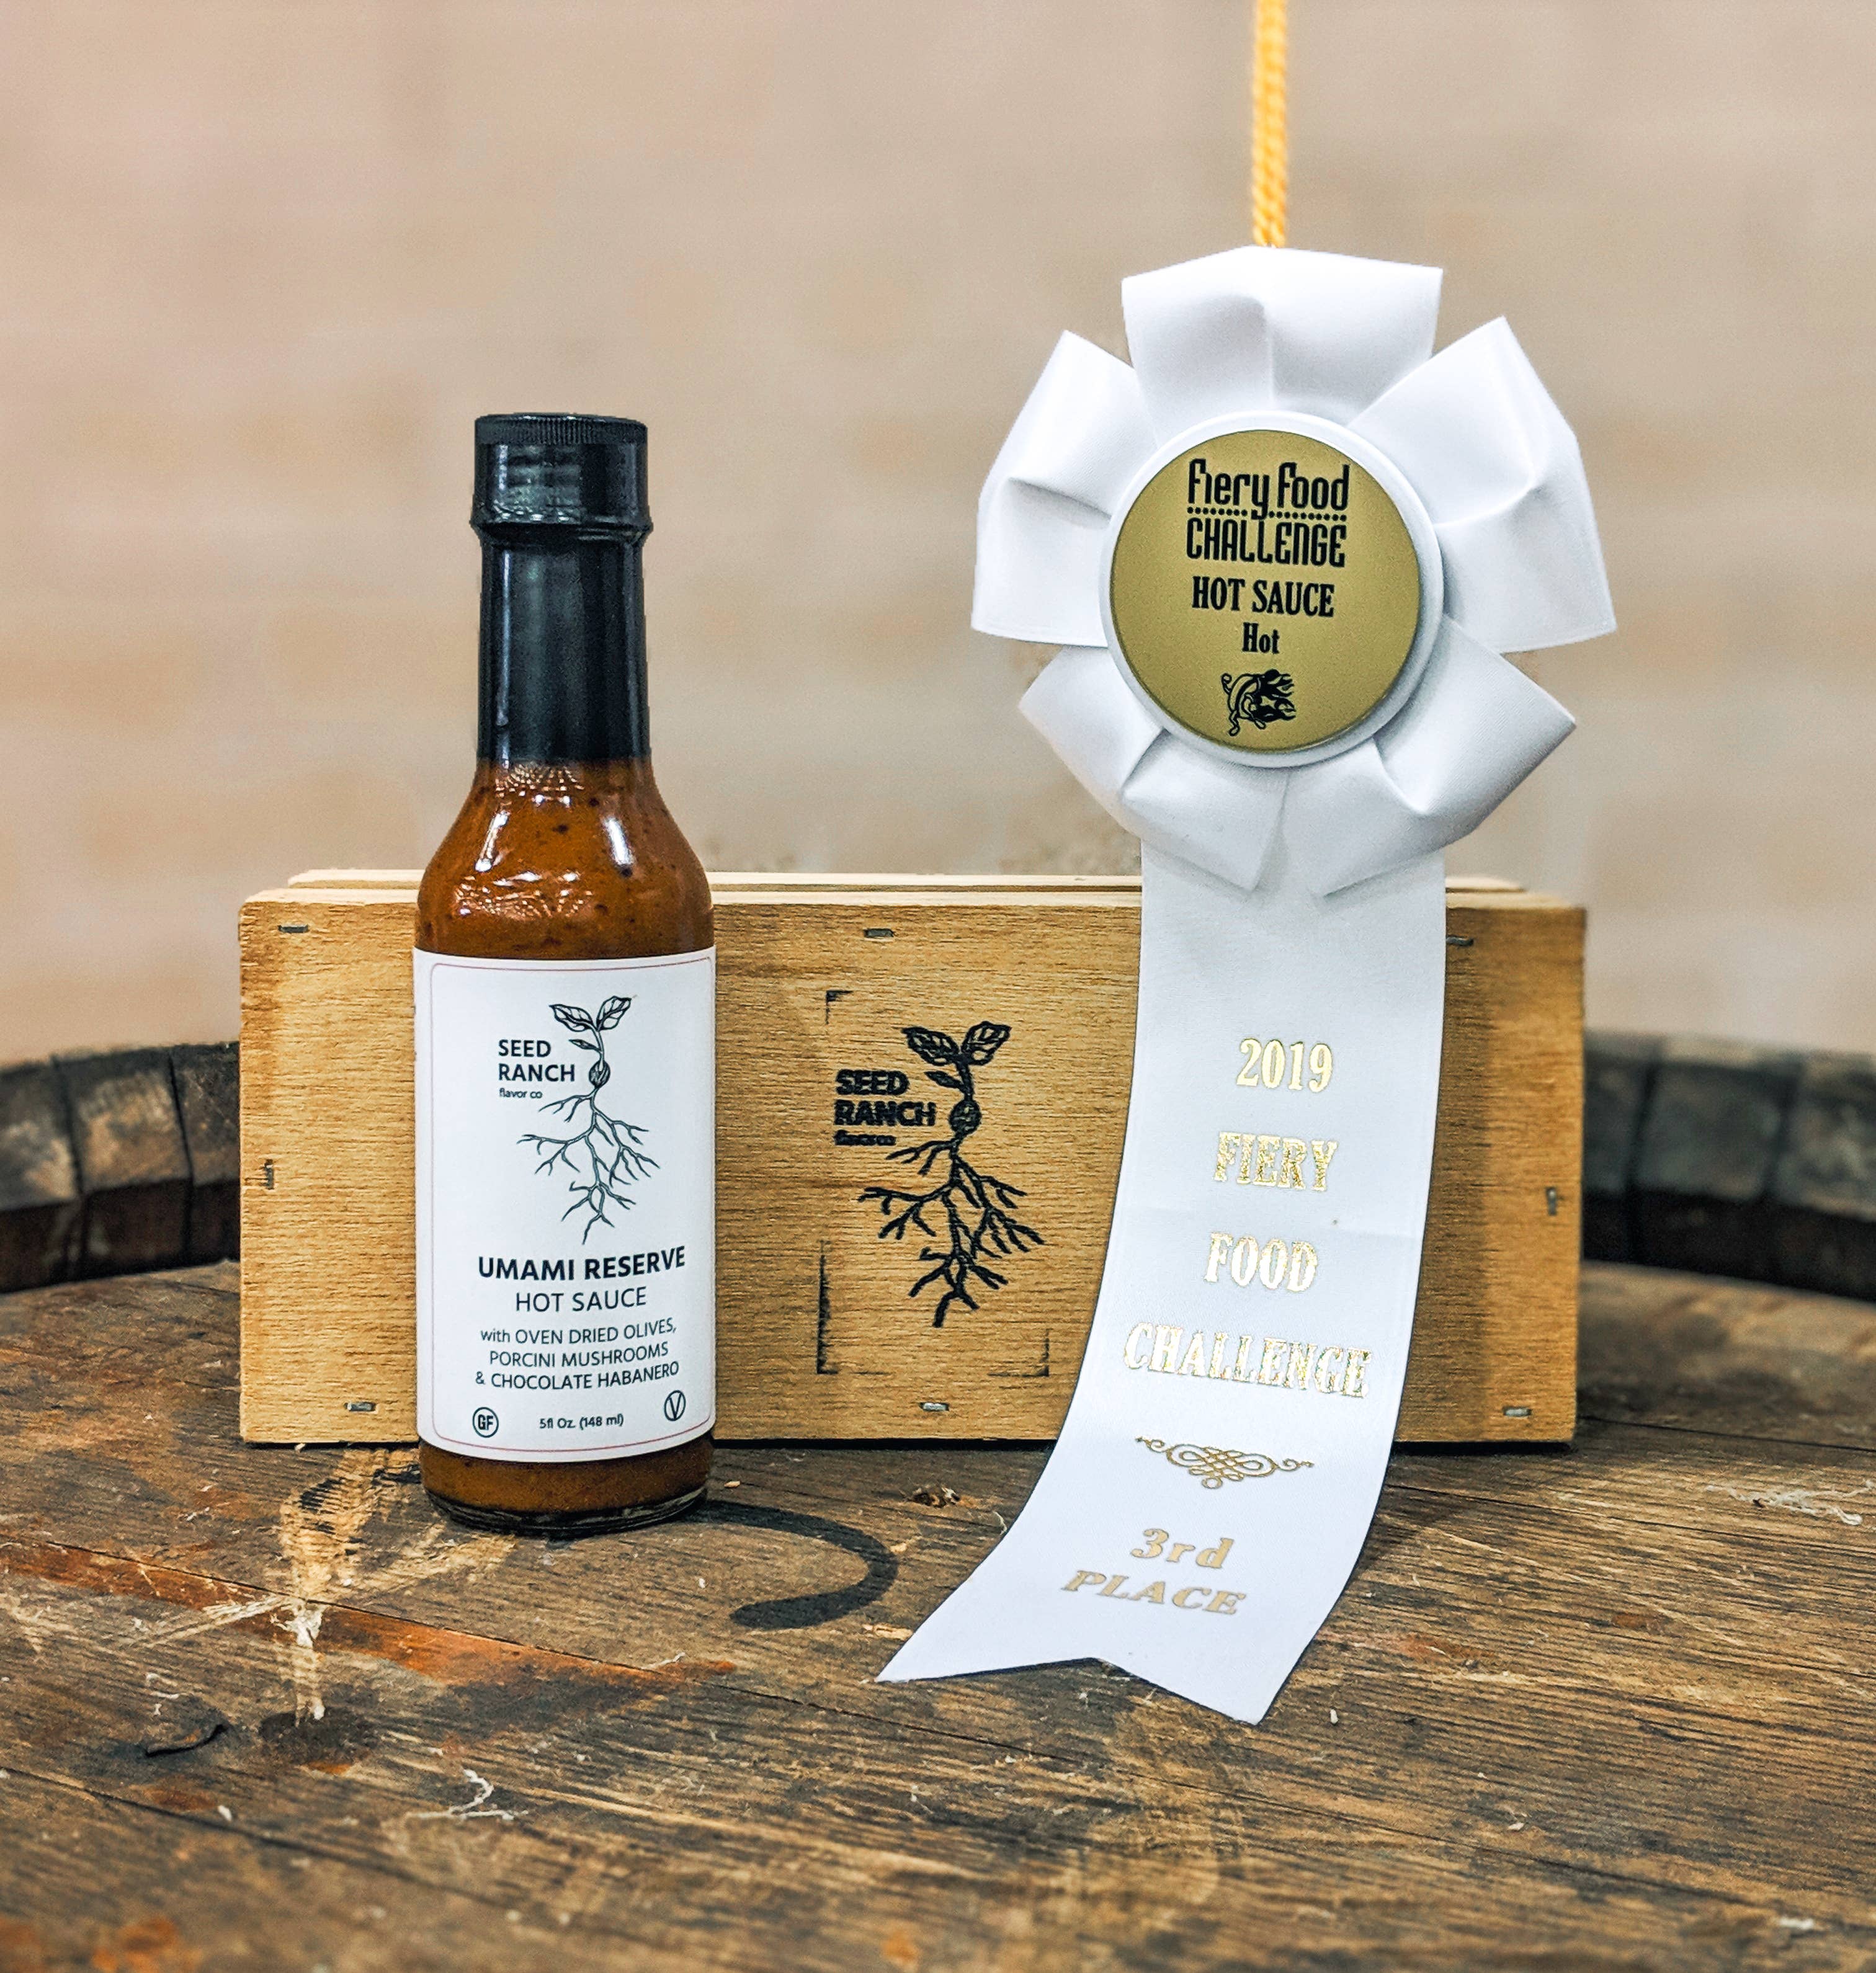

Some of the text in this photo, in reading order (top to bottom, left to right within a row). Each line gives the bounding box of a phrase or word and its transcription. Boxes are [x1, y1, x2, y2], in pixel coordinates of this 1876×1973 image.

[1186, 517, 1347, 568] CHALLENGE
[1192, 576, 1335, 618] HOT SAUCE
[1242, 622, 1280, 654] Hot
[498, 1040, 551, 1057] SEED
[498, 1064, 575, 1082] RANCH
[1236, 1038, 1333, 1092] 2019
[499, 1088, 543, 1099] flavor co
[835, 1069, 910, 1095] SEED
[834, 1099, 937, 1126] RANCH
[1212, 1131, 1339, 1191] FIERY
[478, 1245, 686, 1280] UMAMI RESERVE
[1204, 1231, 1319, 1292] FOOD
[516, 1286, 646, 1312] HOT SAUCE
[480, 1317, 677, 1345] with OVEN DRIED OLIVES,
[489, 1342, 669, 1367] PORCINI MUSHROOMS
[1123, 1322, 1373, 1399] CHALLENGE
[476, 1361, 679, 1390] & CHOCOLATE HABANERO
[478, 1414, 494, 1430] GF
[579, 1415, 602, 1430] (148
[606, 1413, 624, 1426] ml)
[1130, 1528, 1235, 1569] 3rd
[1061, 1570, 1247, 1615] PLACE
